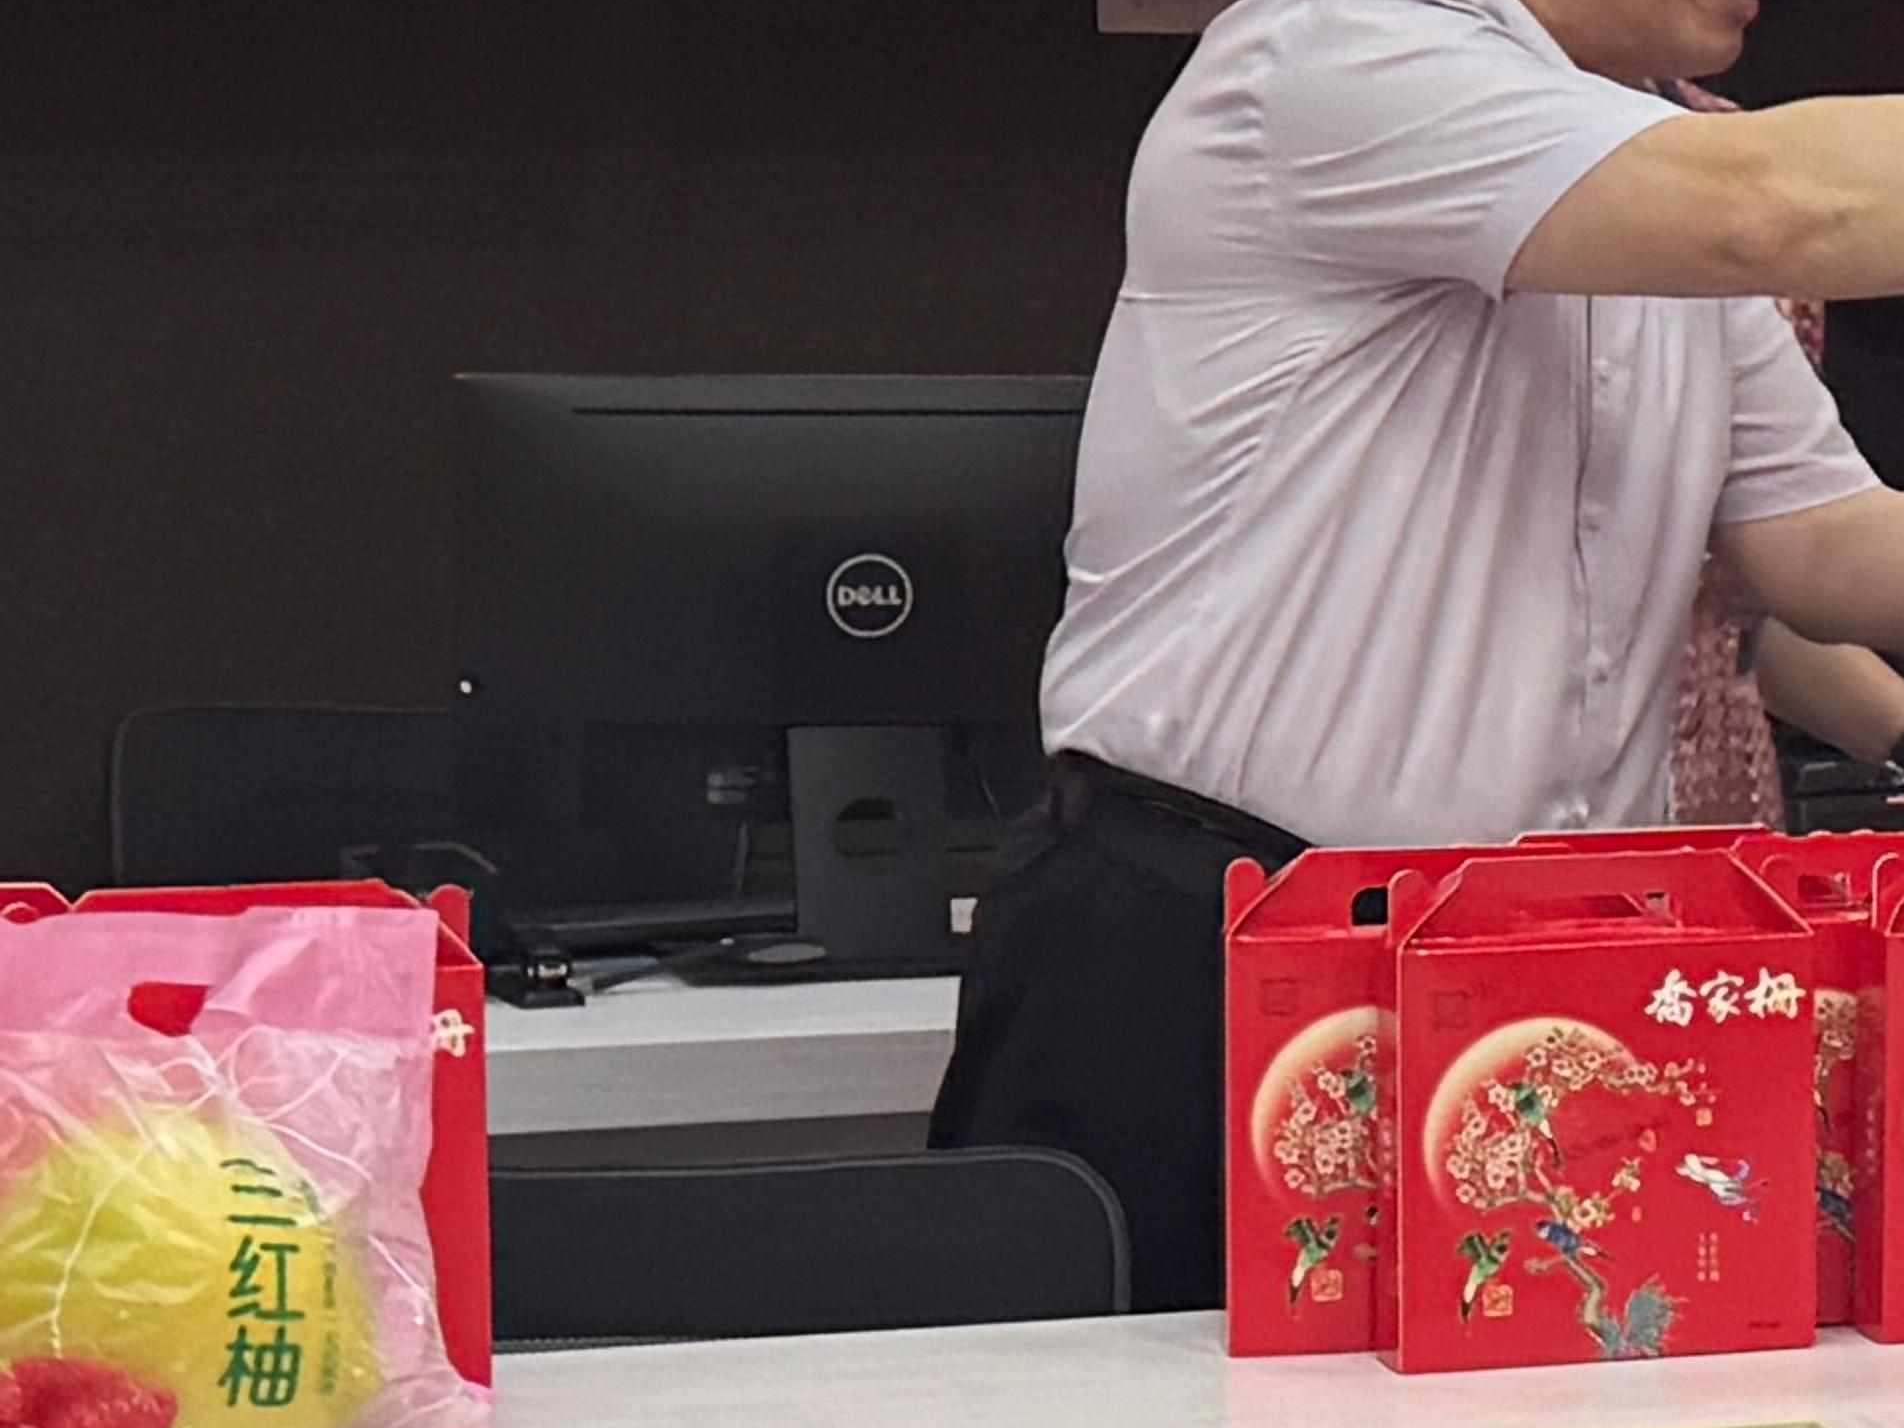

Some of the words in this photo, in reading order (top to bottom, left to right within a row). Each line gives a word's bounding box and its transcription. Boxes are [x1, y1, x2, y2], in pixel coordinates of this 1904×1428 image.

[838, 585, 902, 606] DELL
[218, 1157, 306, 1407] 三红柚
